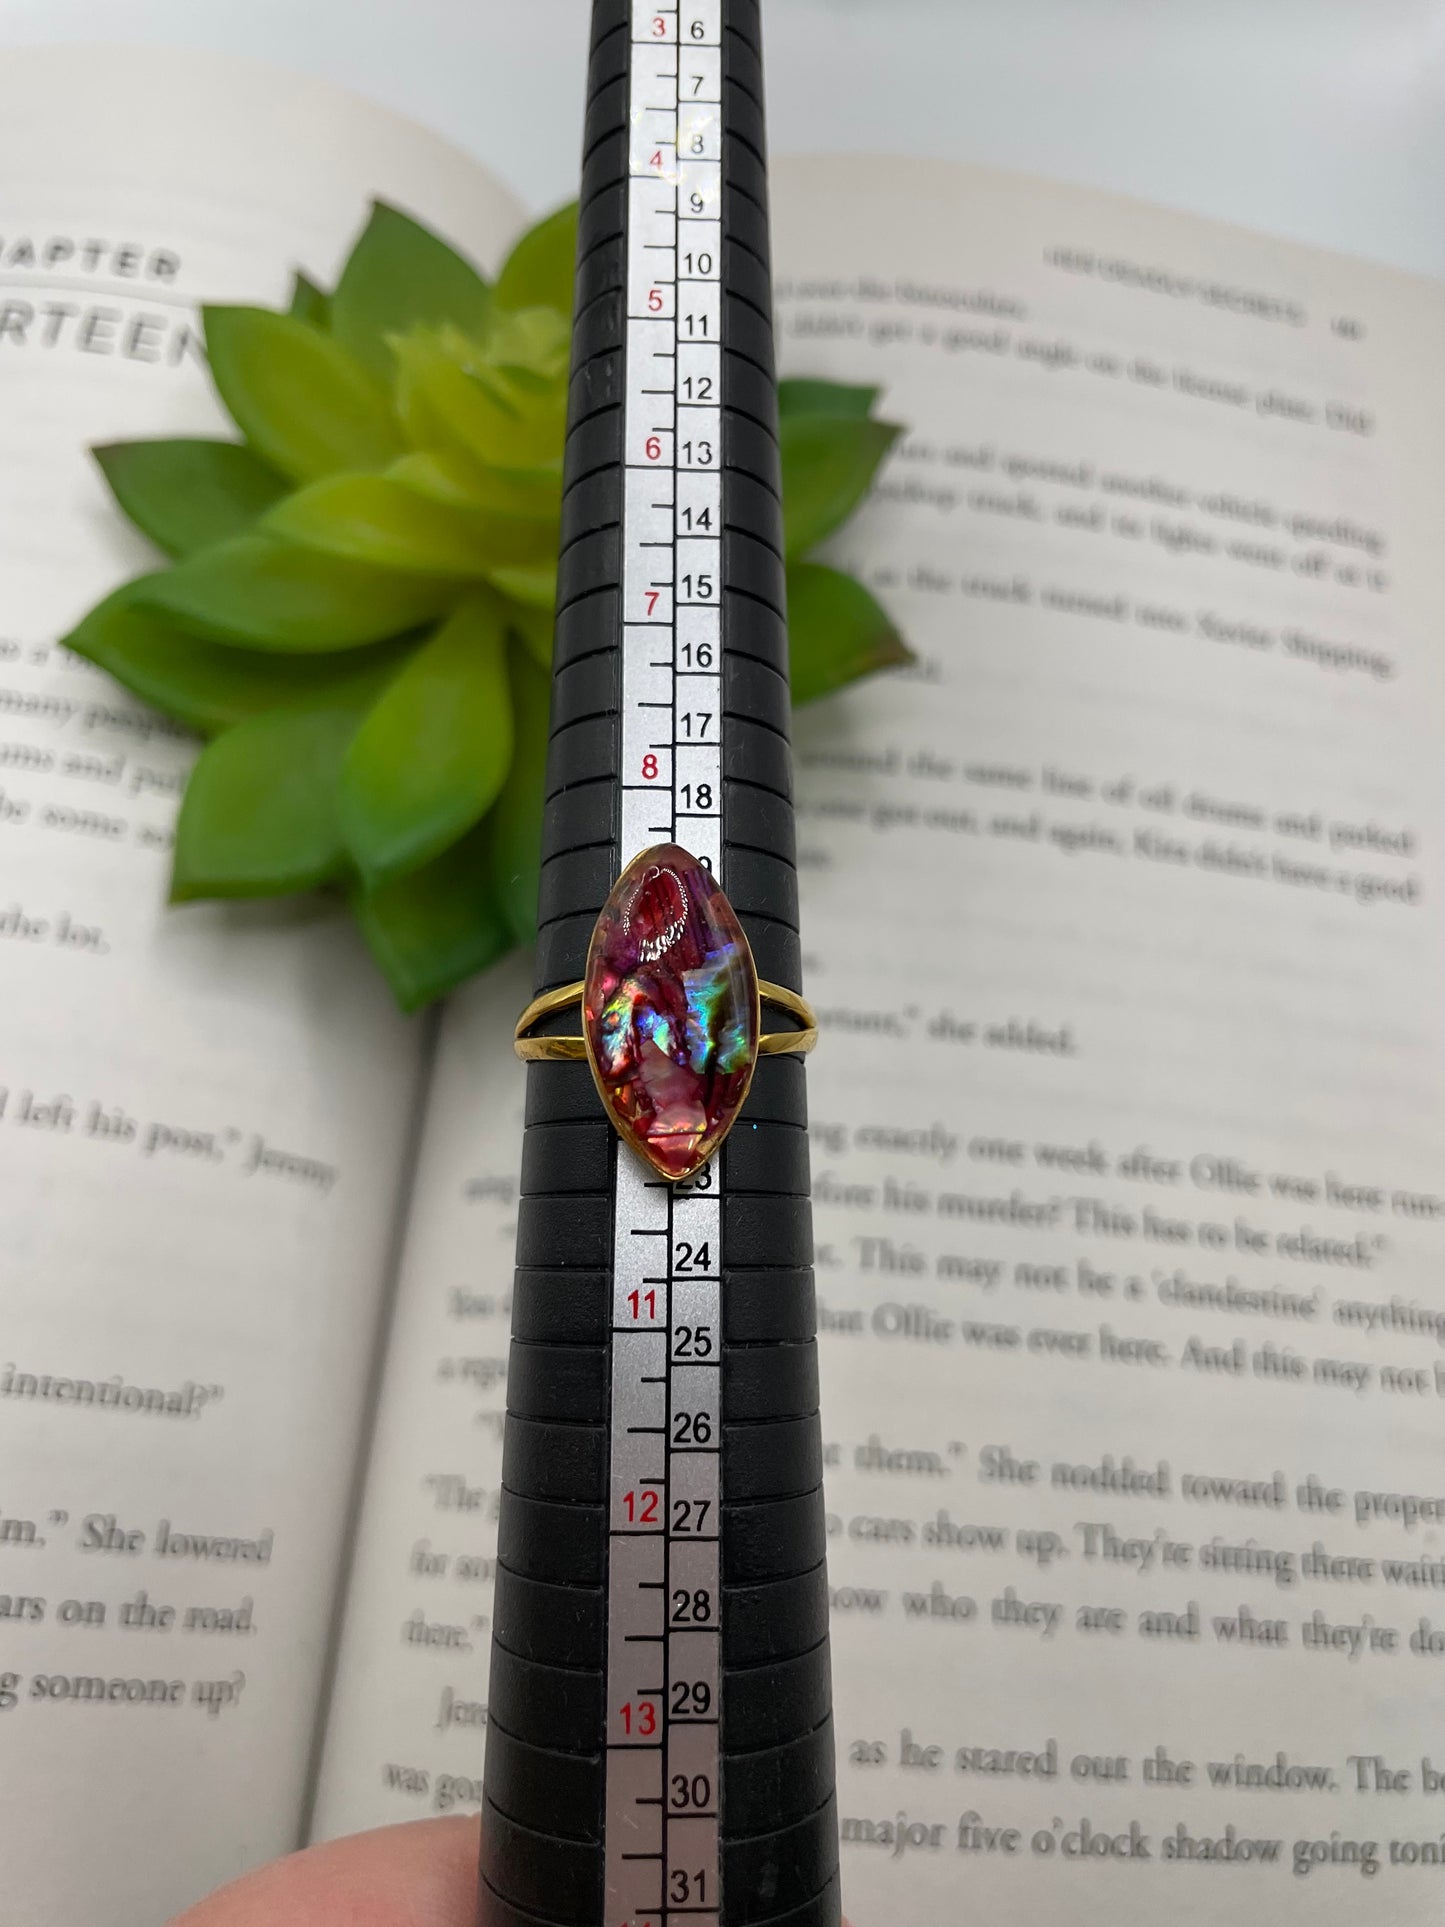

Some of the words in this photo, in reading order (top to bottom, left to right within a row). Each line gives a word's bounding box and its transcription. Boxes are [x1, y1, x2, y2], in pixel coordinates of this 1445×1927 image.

[652, 17, 666, 37] 3
[690, 21, 704, 40] 6
[691, 76, 704, 94] 7
[690, 135, 704, 153] 8
[650, 151, 662, 168] 4
[690, 194, 704, 213] 9
[0, 235, 182, 285] APTER
[684, 254, 712, 273] 10
[648, 290, 662, 311] 5
[684, 316, 709, 336] 11
[683, 378, 712, 398] 12
[646, 437, 661, 459] 6
[683, 443, 712, 465] 13
[682, 508, 712, 530] 14
[682, 576, 712, 598] 15
[645, 592, 659, 615] 7
[682, 643, 712, 667] 16
[681, 713, 712, 737] 17
[641, 754, 658, 780] 8
[681, 784, 712, 809] 18
[82, 1096, 139, 1146] his
[675, 1161, 712, 1191] 3
[674, 1243, 711, 1271] 24
[626, 1289, 656, 1320] 11
[674, 1327, 712, 1356] 25
[673, 1412, 712, 1443] 26
[976, 1442, 1042, 1488] She
[1049, 1453, 1173, 1500] nodded
[1180, 1470, 1288, 1514] toward
[1294, 1472, 1347, 1517] the
[623, 1490, 658, 1522] 12
[672, 1501, 710, 1532] 27
[0, 1509, 70, 1551] m."
[77, 1512, 147, 1558] She
[154, 1517, 276, 1567] lowered
[919, 1508, 1010, 1554] show
[455, 1554, 497, 1582] an
[56, 1598, 109, 1629] on
[118, 1589, 177, 1633] the
[672, 1589, 711, 1622] 28
[900, 1578, 980, 1622] who
[989, 1583, 1065, 1640] they
[1074, 1603, 1129, 1633] are
[1136, 1599, 1200, 1643] and
[1210, 1603, 1290, 1650] what
[1301, 1608, 1402, 1664] they're
[30, 1673, 187, 1708] someone
[672, 1682, 711, 1714] 29
[619, 1702, 656, 1735] 13
[848, 1738, 888, 1769] as
[899, 1726, 945, 1771] he
[953, 1736, 1060, 1780] stared
[1069, 1753, 1131, 1784] out
[1143, 1744, 1198, 1787] the
[1205, 1750, 1339, 1794] window.
[1345, 1753, 1413, 1795] The
[671, 1774, 711, 1808] 30
[840, 1809, 948, 1862] major
[956, 1808, 1023, 1856] five
[1030, 1815, 1152, 1864] o'clock
[1160, 1821, 1284, 1868] shadow
[1292, 1830, 1381, 1879] going
[670, 1868, 706, 1904] 31
